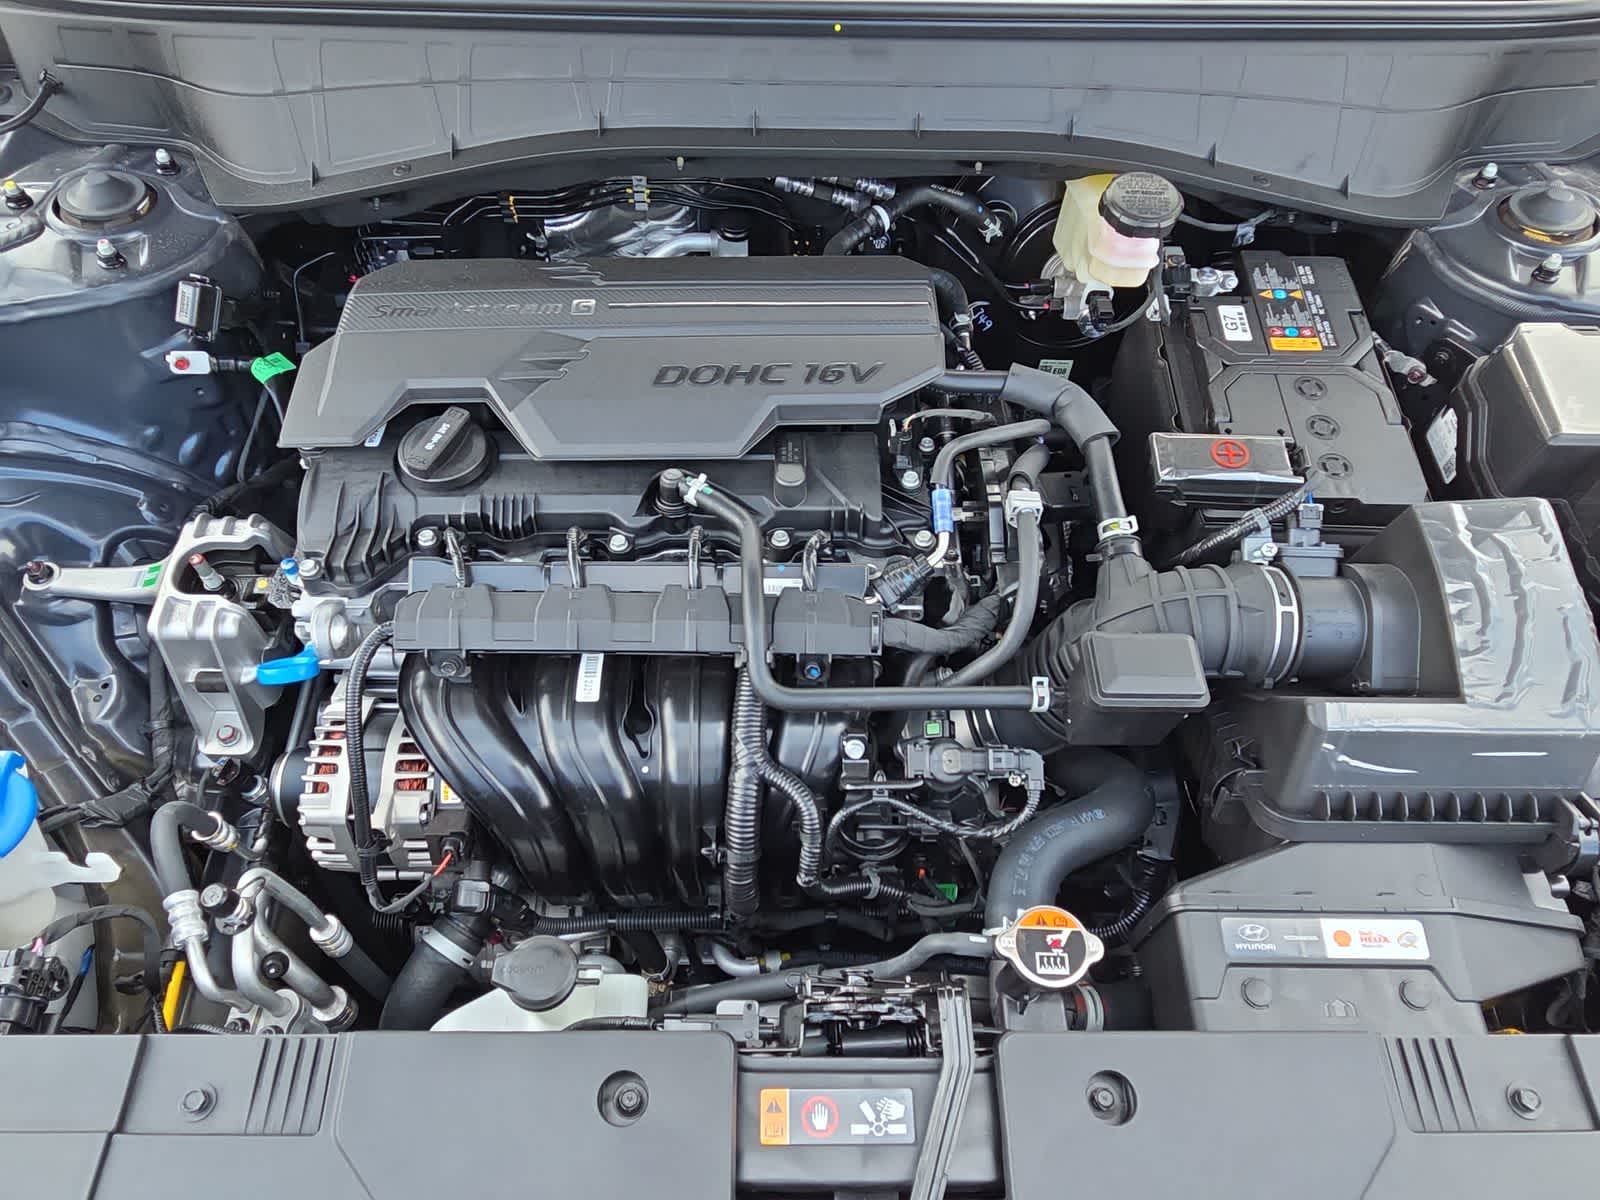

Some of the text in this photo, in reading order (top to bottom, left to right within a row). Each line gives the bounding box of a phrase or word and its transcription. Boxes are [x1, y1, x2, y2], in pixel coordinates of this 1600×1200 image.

[652, 362, 886, 386] DOHC 16V
[1235, 943, 1277, 951] HYUNDAI
